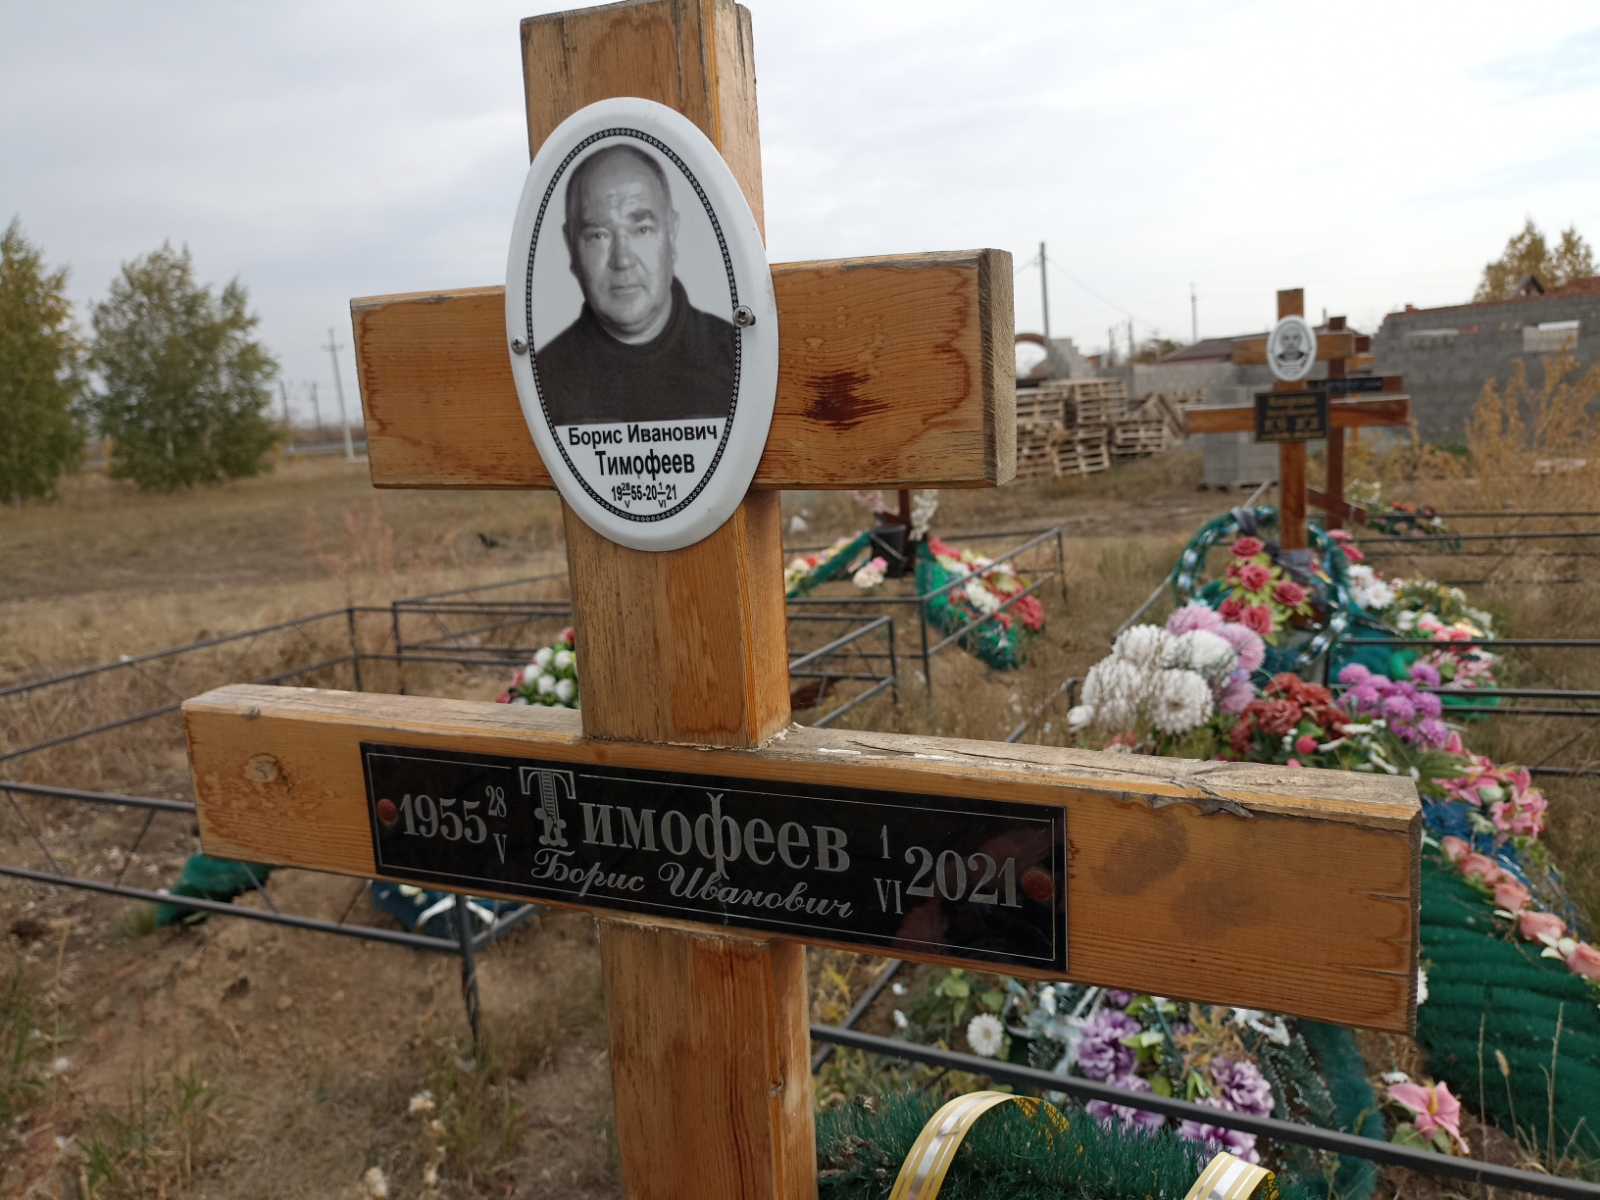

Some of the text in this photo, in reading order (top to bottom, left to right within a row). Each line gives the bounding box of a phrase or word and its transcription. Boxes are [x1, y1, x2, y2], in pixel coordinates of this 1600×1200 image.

[568, 424, 718, 449] Борис Иванович
[595, 449, 695, 481] Тимофеев
[485, 785, 507, 818] 28
[400, 766, 1023, 908] 1955 Тимофеев 2021
[492, 833, 904, 915] V VI
[531, 848, 855, 919] Борис Иванович
